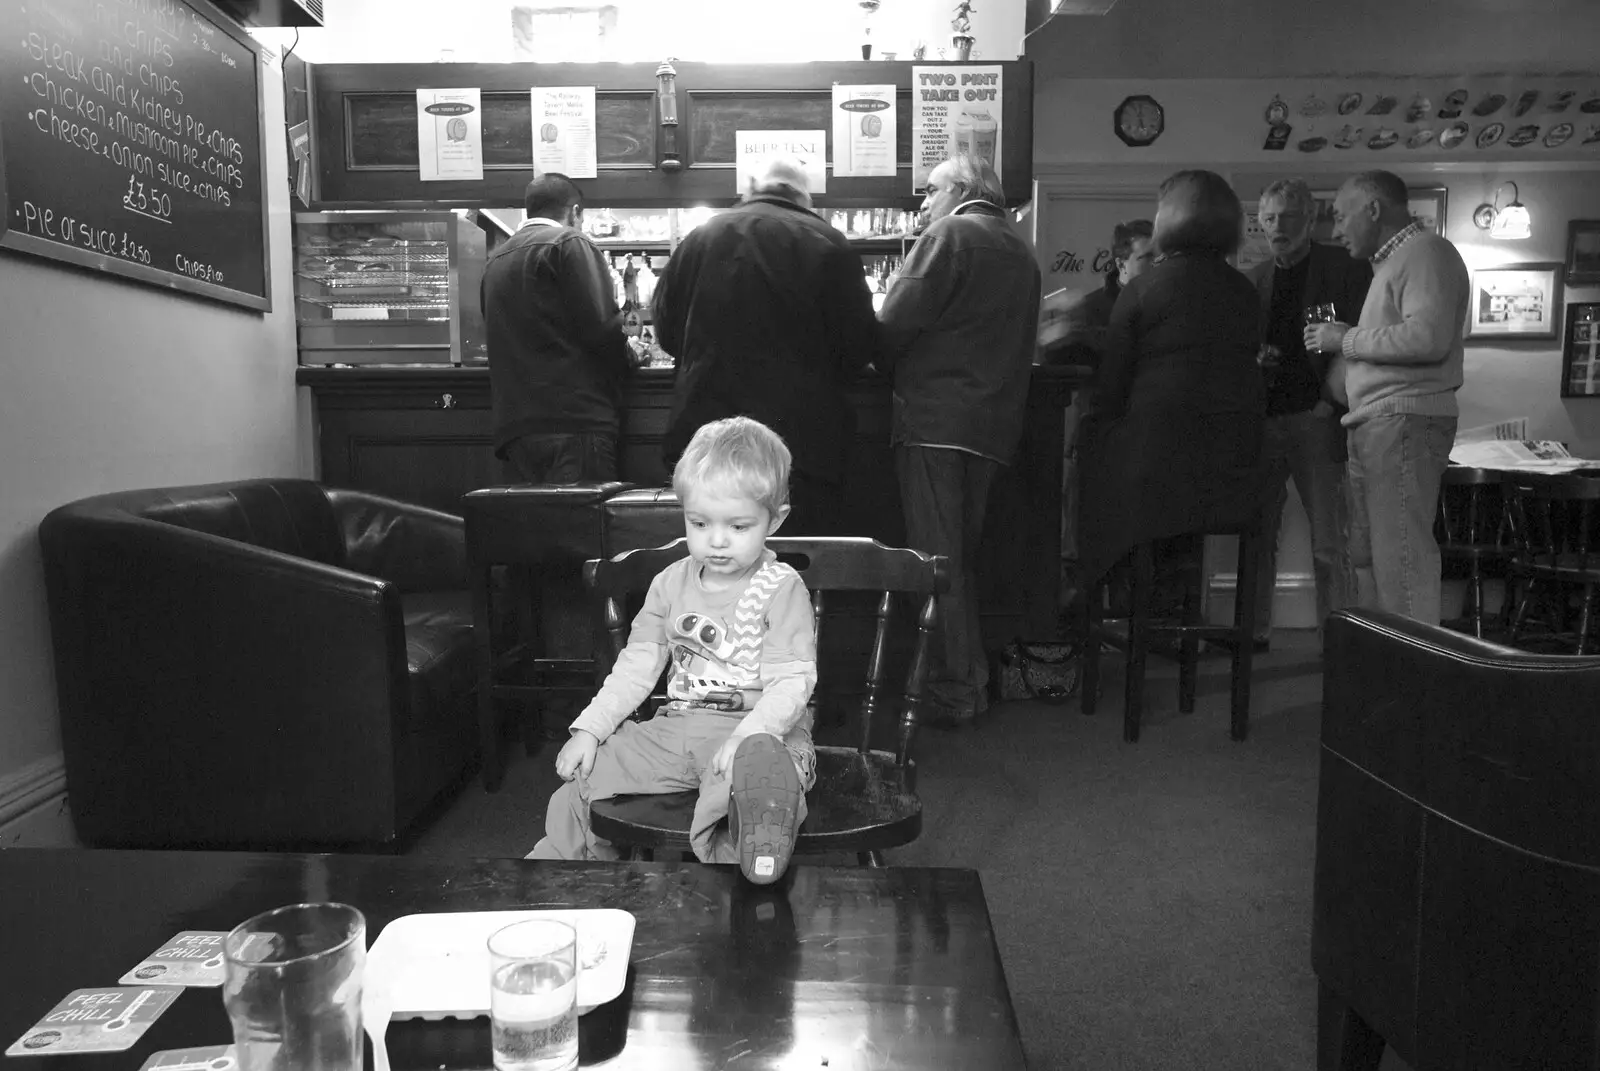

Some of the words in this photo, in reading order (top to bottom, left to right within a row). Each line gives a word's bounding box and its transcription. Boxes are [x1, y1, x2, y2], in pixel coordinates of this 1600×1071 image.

[100, 39, 133, 76] and
[28, 32, 88, 84] Steak
[92, 66, 127, 108] and
[919, 73, 956, 86] TWO
[961, 73, 998, 86] PINT
[31, 72, 106, 127] Chicken
[920, 89, 959, 101] TAKE
[964, 89, 997, 101] OUT
[35, 108, 100, 154] Cheese
[744, 143, 778, 154] BEER
[783, 142, 816, 154] TENT
[60, 216, 76, 242] or
[1052, 250, 1085, 273] The
[1092, 248, 1113, 273] Co
[175, 935, 223, 945] FEEL
[155, 947, 211, 958] CHILL
[68, 992, 123, 1006] FEEL
[46, 1008, 112, 1022] CHILL
